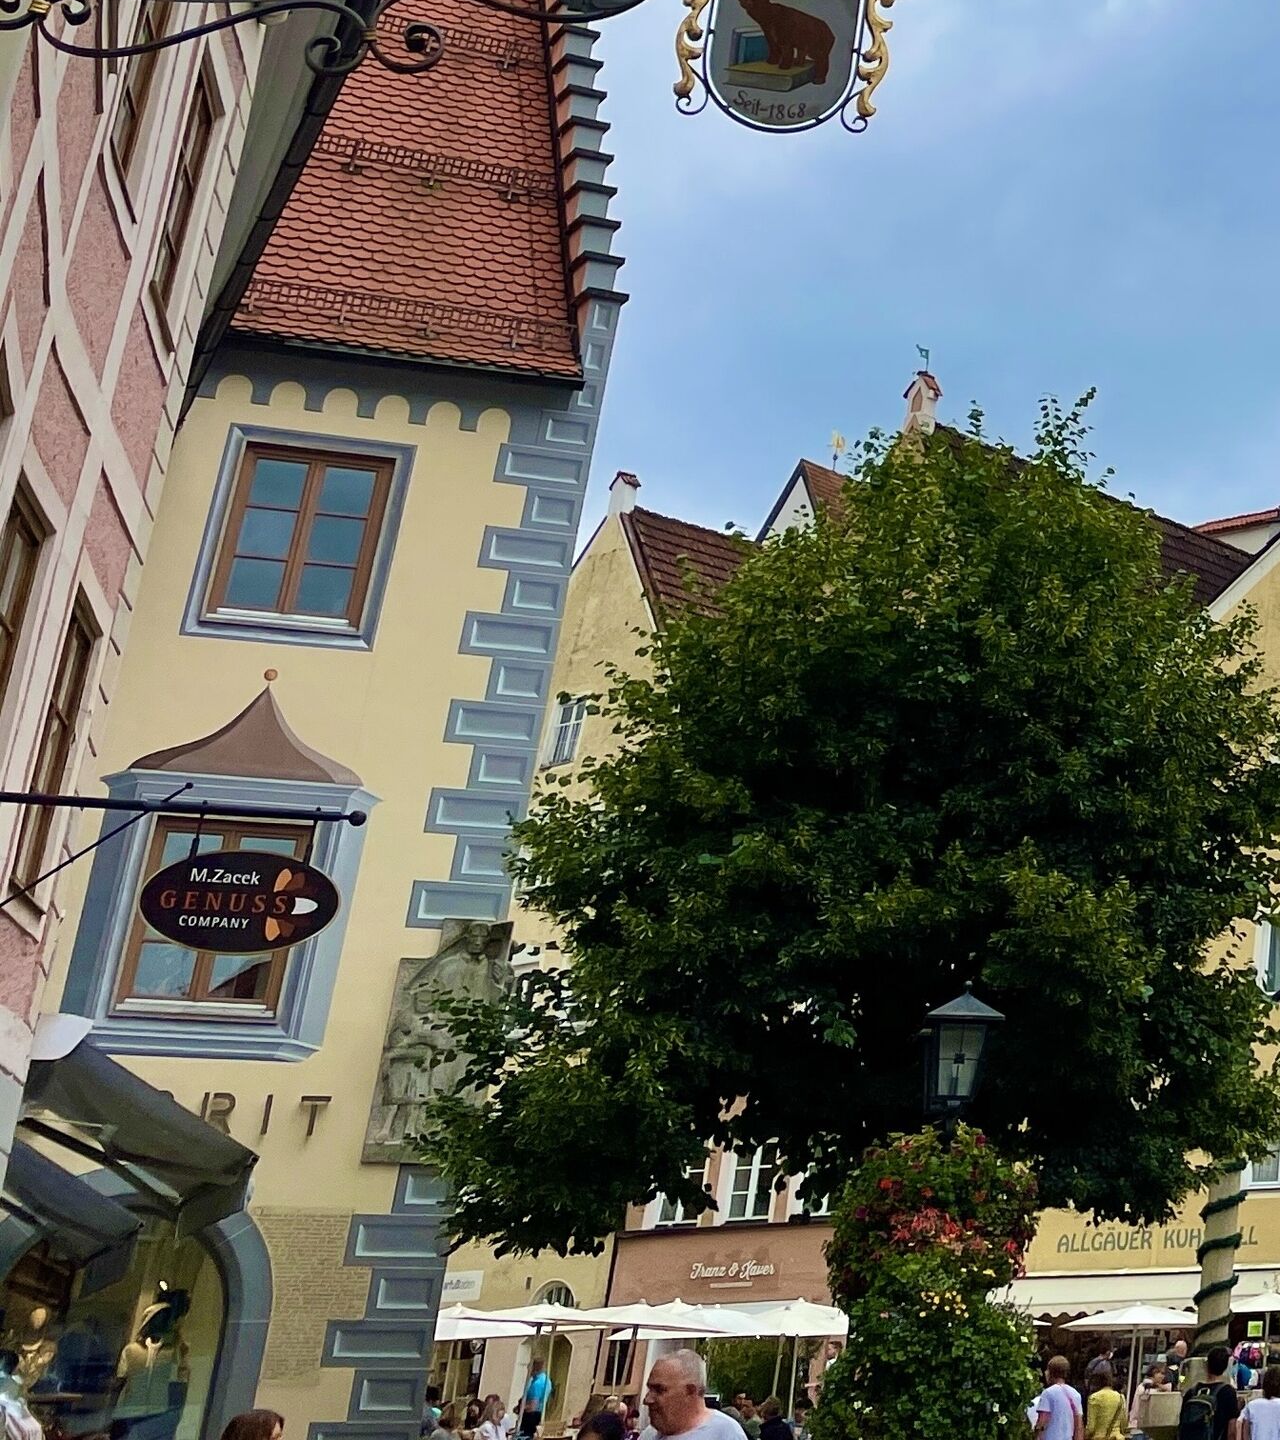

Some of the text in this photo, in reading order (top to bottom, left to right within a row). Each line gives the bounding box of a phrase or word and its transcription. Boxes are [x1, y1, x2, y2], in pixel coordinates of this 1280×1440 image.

[190, 867, 261, 885] M.Zacek
[160, 889, 288, 914] GENUSS
[178, 914, 250, 929] COMPANY
[199, 1091, 333, 1137] RIT
[728, 1262, 739, 1277] &
